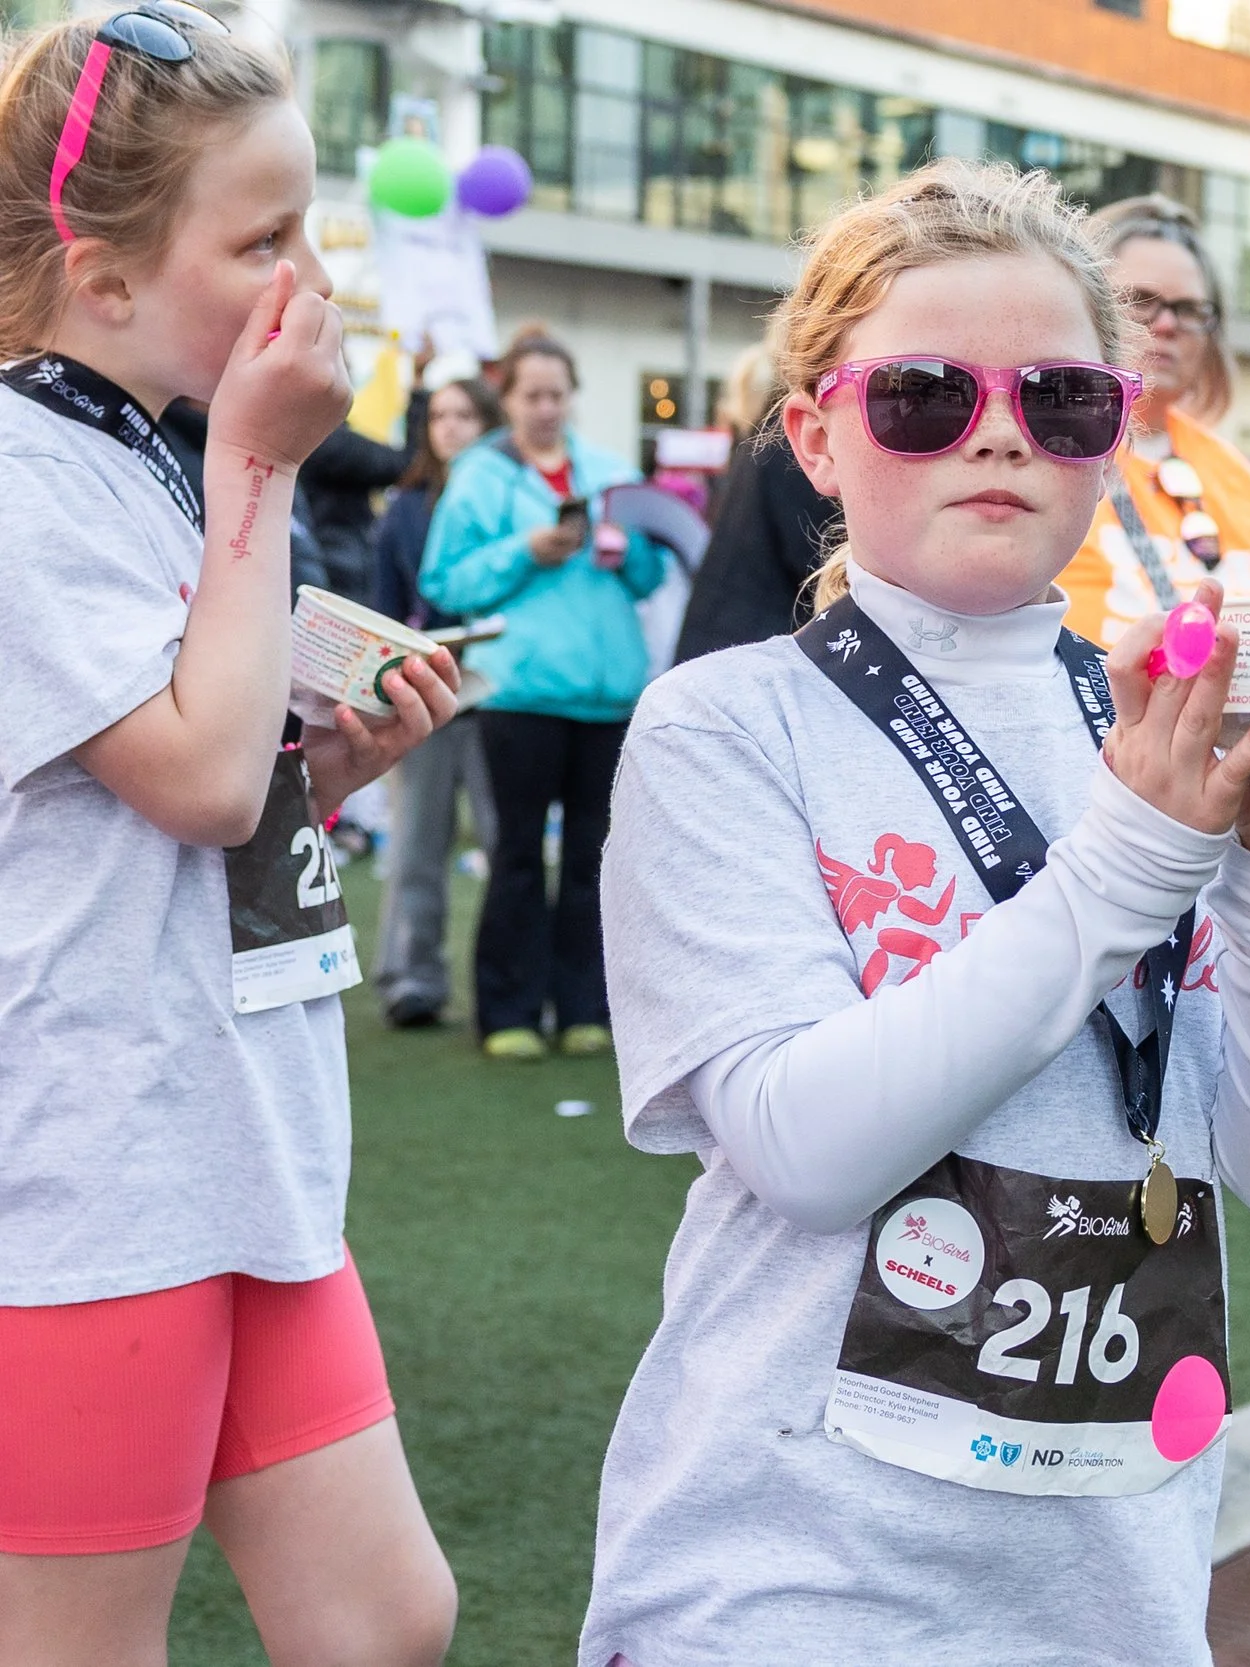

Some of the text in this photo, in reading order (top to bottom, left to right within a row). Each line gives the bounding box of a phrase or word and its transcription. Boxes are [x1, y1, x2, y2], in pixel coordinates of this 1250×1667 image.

[51, 379, 106, 419] BIOGirls
[120, 402, 151, 437] FIND
[249, 475, 264, 498] am
[1074, 675, 1102, 714] FIND
[1083, 660, 1112, 699] FIND
[901, 674, 1017, 812] FIND YOUR KIND
[893, 694, 1013, 843] FIND YOUR KIND
[889, 717, 1002, 870] FIND YOUR KIND
[1079, 1217, 1130, 1237] BIOGirls
[921, 1233, 972, 1264] BIOGirls
[885, 1259, 957, 1296] SCHEELS
[977, 1278, 1140, 1384] 216
[836, 1387, 939, 1420] Site Director: Kylie Holland
[840, 1376, 940, 1409] Moorhead Good Shepherd
[834, 1397, 917, 1425] Phone: 701-269-9637
[1031, 1449, 1064, 1466] ND
[1068, 1458, 1124, 1467] FOUNDATION
